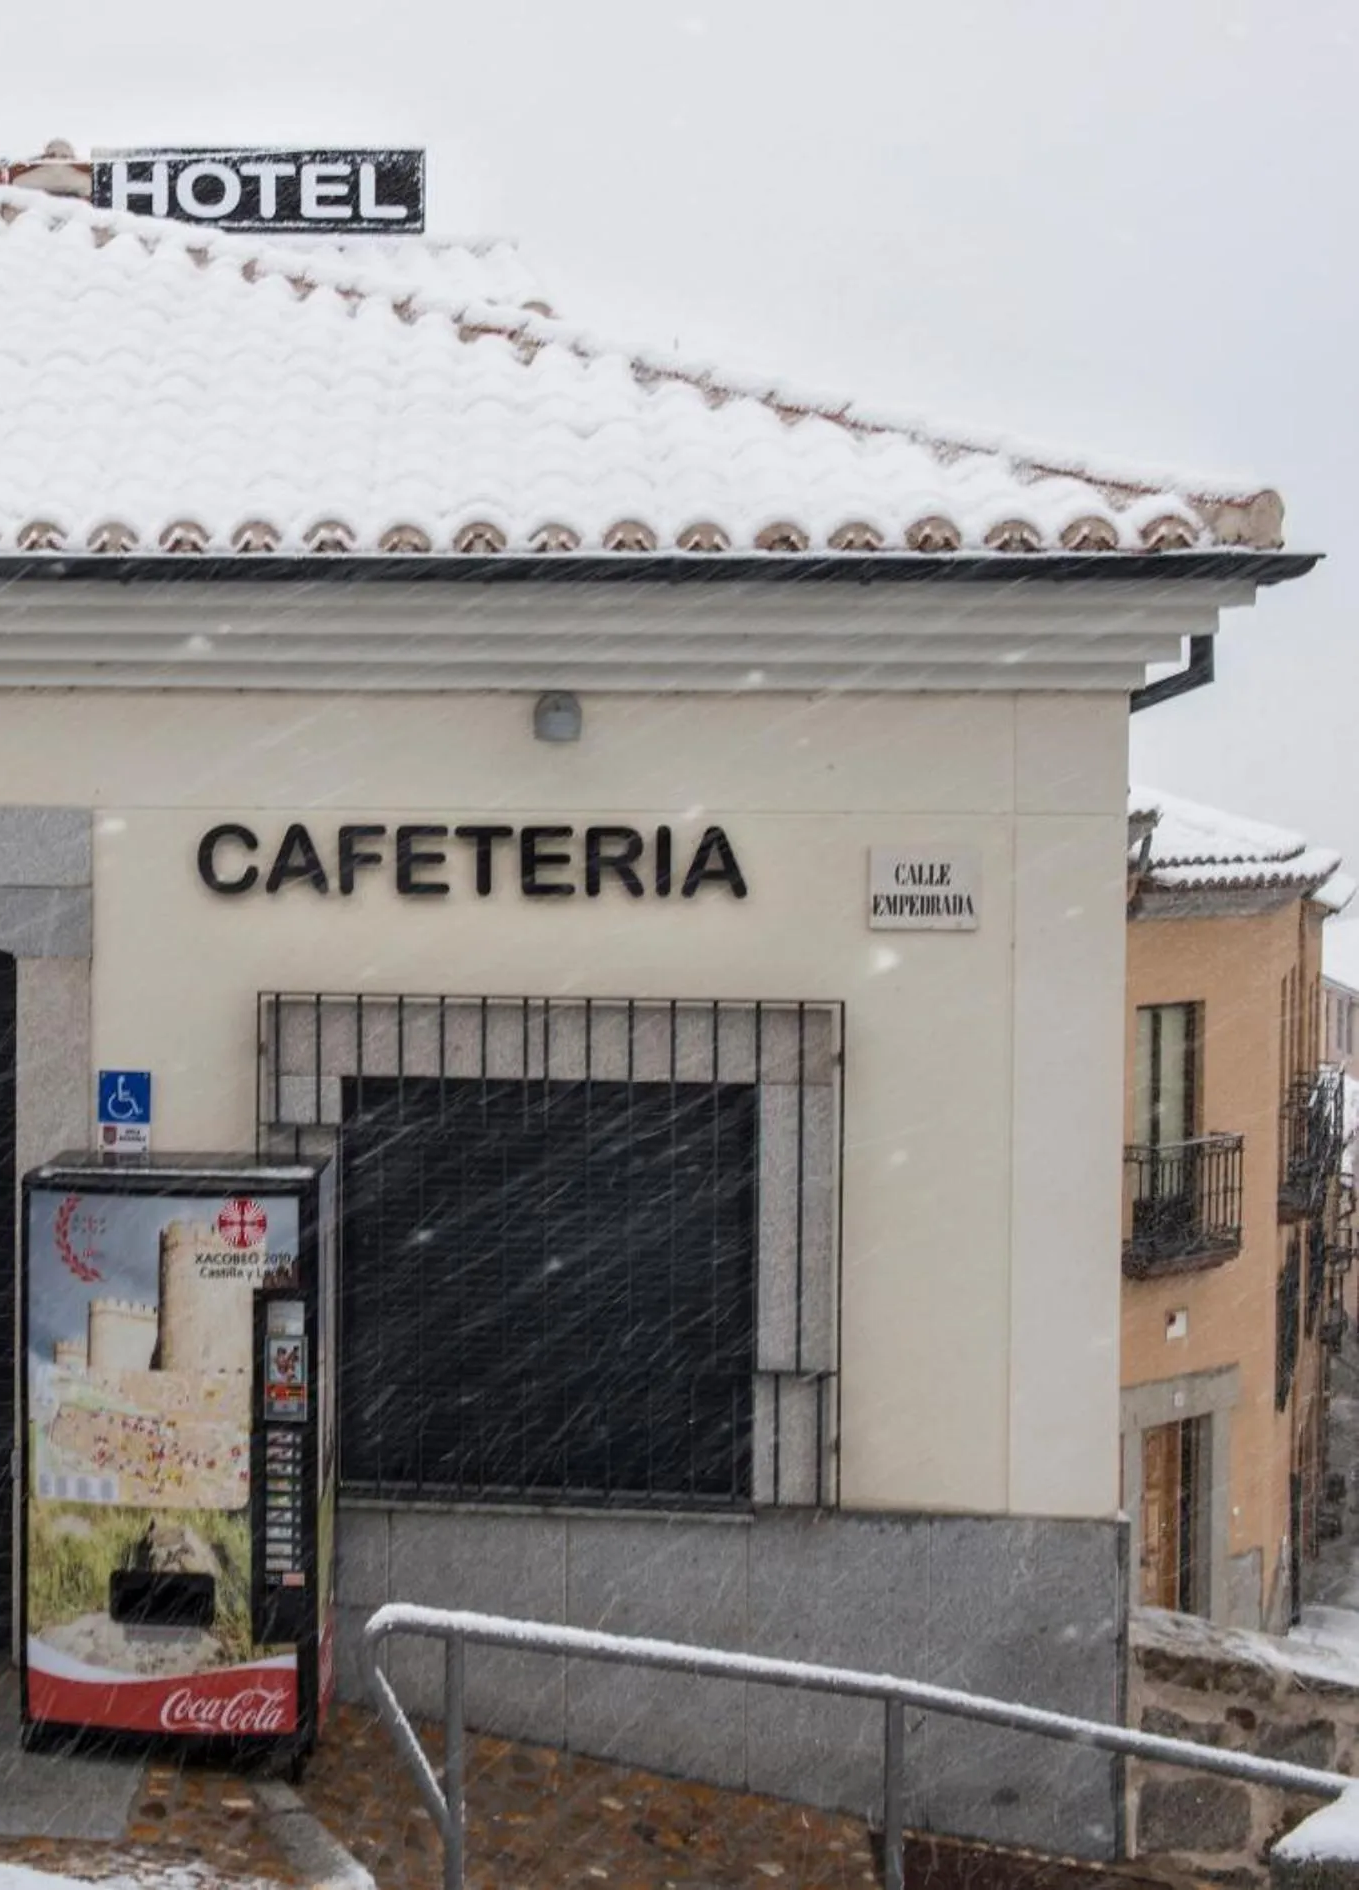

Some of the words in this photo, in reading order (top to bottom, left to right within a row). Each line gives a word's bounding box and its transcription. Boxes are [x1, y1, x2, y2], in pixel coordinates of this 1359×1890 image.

[112, 161, 408, 220] HOTEL
[197, 823, 748, 898] CAFETERIA
[894, 863, 951, 886] CALLE
[872, 894, 974, 917] EMPEDRADA
